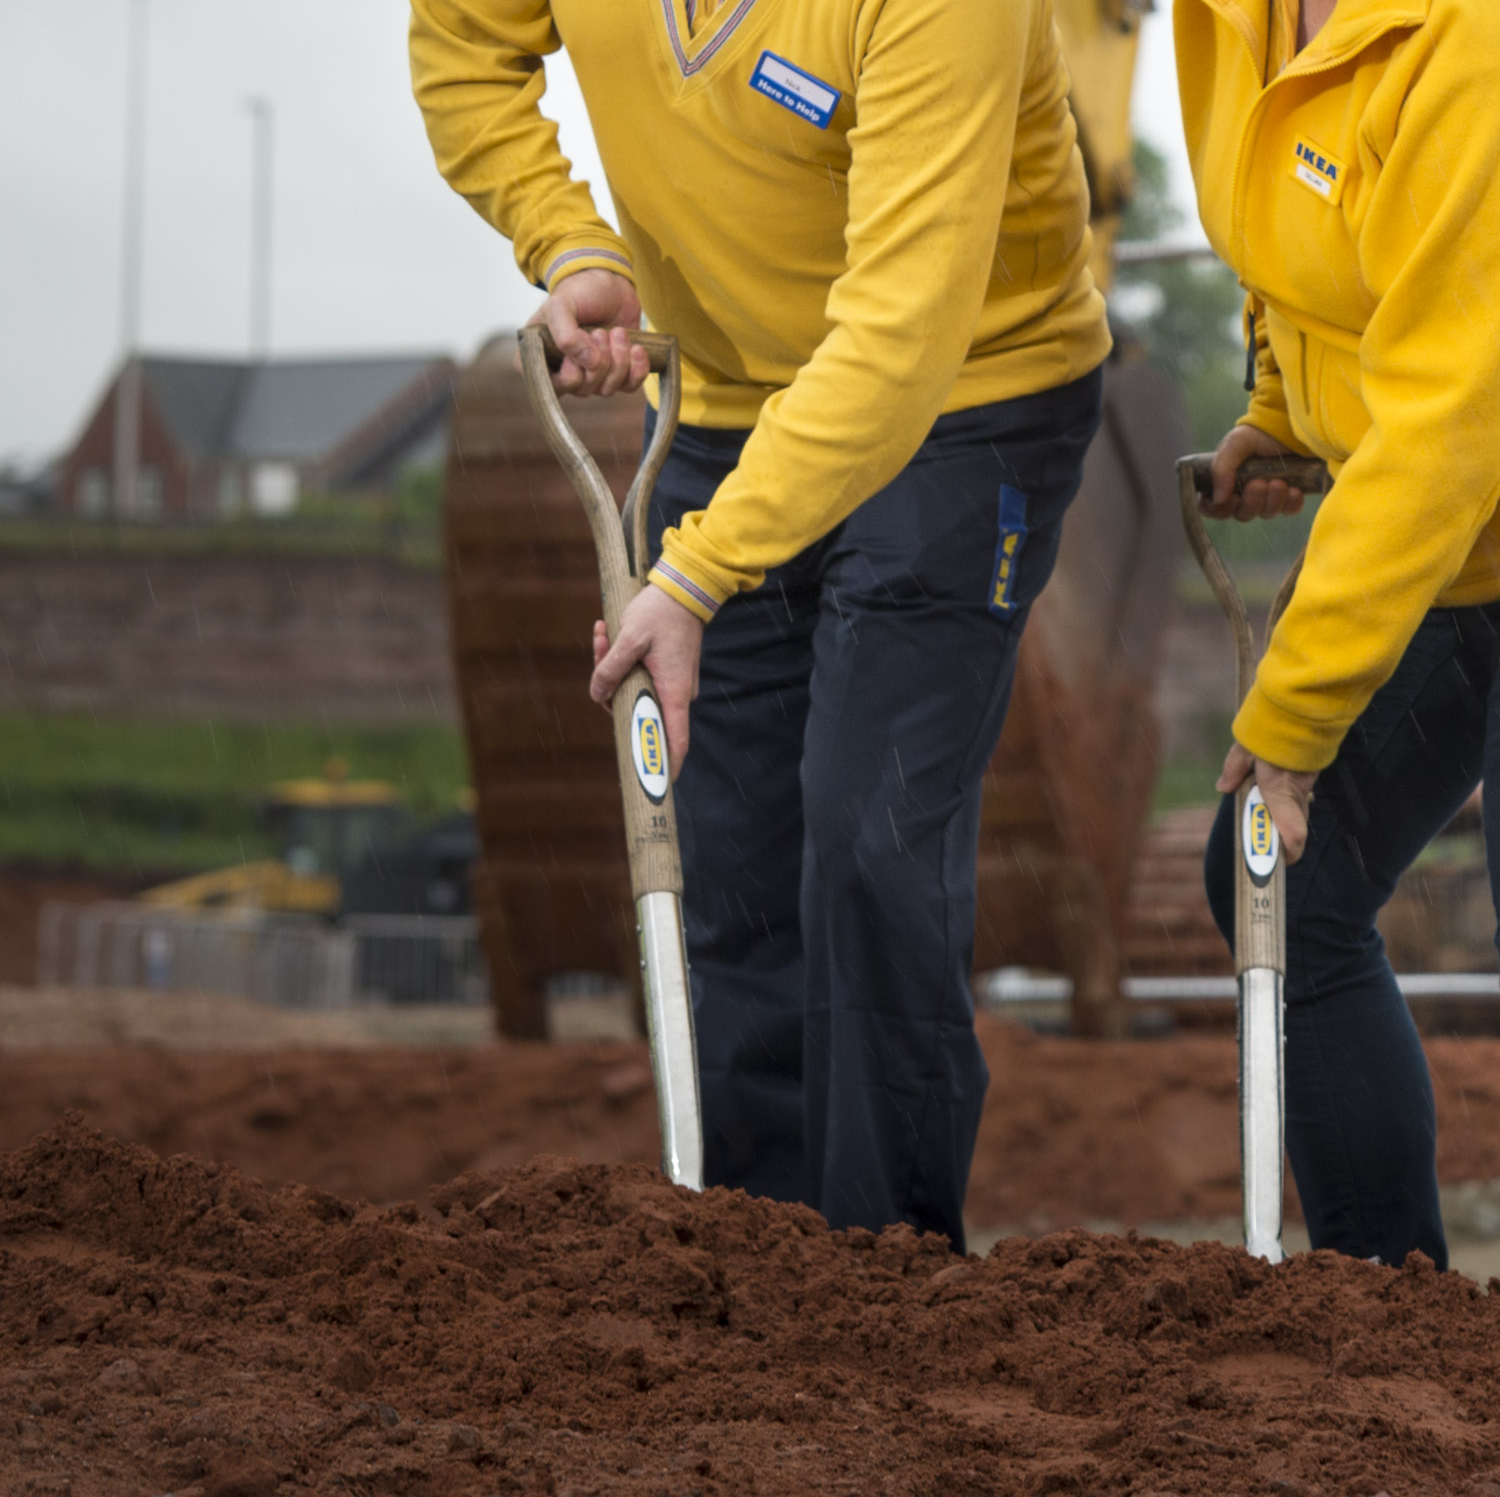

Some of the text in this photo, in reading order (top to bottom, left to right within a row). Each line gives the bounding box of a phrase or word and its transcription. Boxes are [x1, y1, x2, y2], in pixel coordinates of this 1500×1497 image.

[758, 79, 820, 121] Here to Help
[1296, 142, 1337, 181] IKEA
[645, 724, 658, 767] IKEA
[1256, 809, 1266, 848] IKEA
